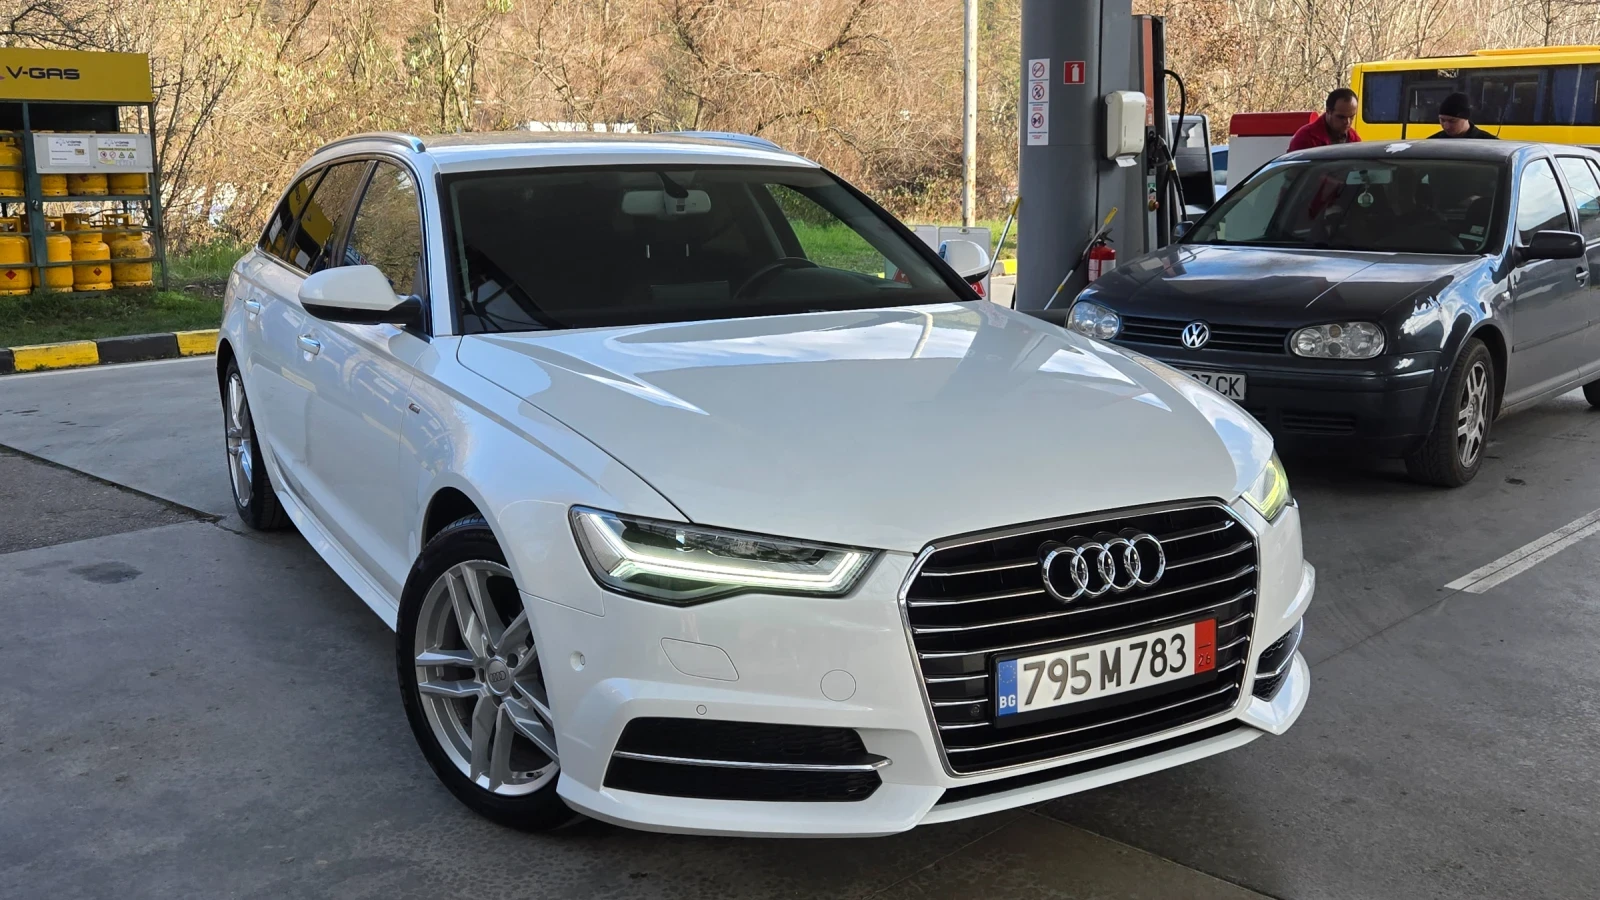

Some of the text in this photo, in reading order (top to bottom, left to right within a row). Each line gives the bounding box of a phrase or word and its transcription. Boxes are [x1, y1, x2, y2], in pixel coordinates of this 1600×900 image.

[6, 66, 80, 80] V-GAS
[1023, 633, 1187, 706] 795 M 783
[999, 694, 1016, 709] BG
